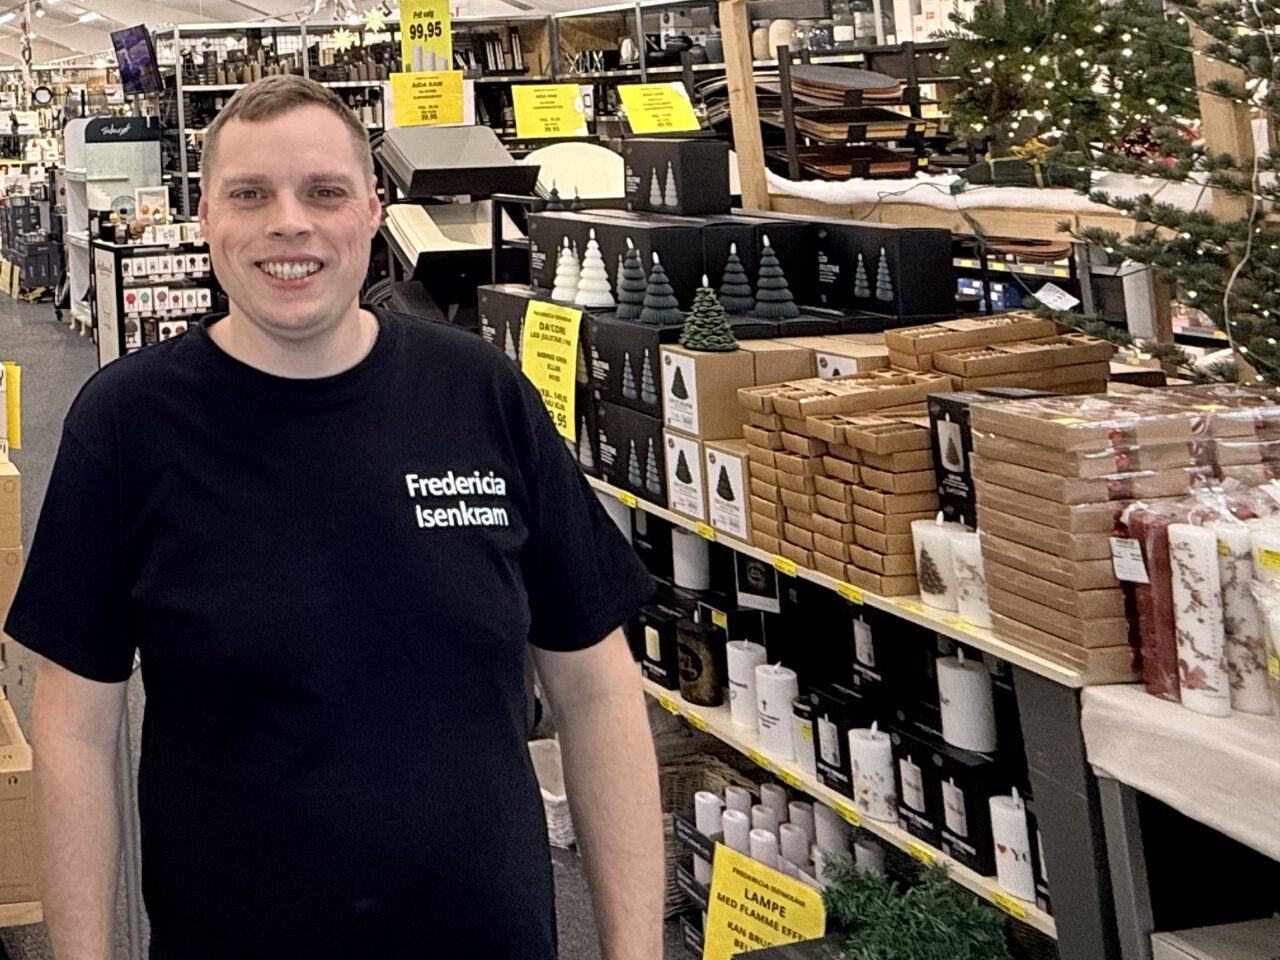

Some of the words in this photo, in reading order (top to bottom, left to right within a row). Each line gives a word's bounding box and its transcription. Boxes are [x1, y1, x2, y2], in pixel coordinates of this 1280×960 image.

[409, 20, 442, 42] 99,95
[405, 470, 506, 497] Fredericia
[415, 500, 510, 528] Isenkram
[716, 892, 738, 909] MED
[739, 903, 780, 931] FLAMME
[744, 887, 787, 918] LAMPE
[727, 920, 747, 937] KAN
